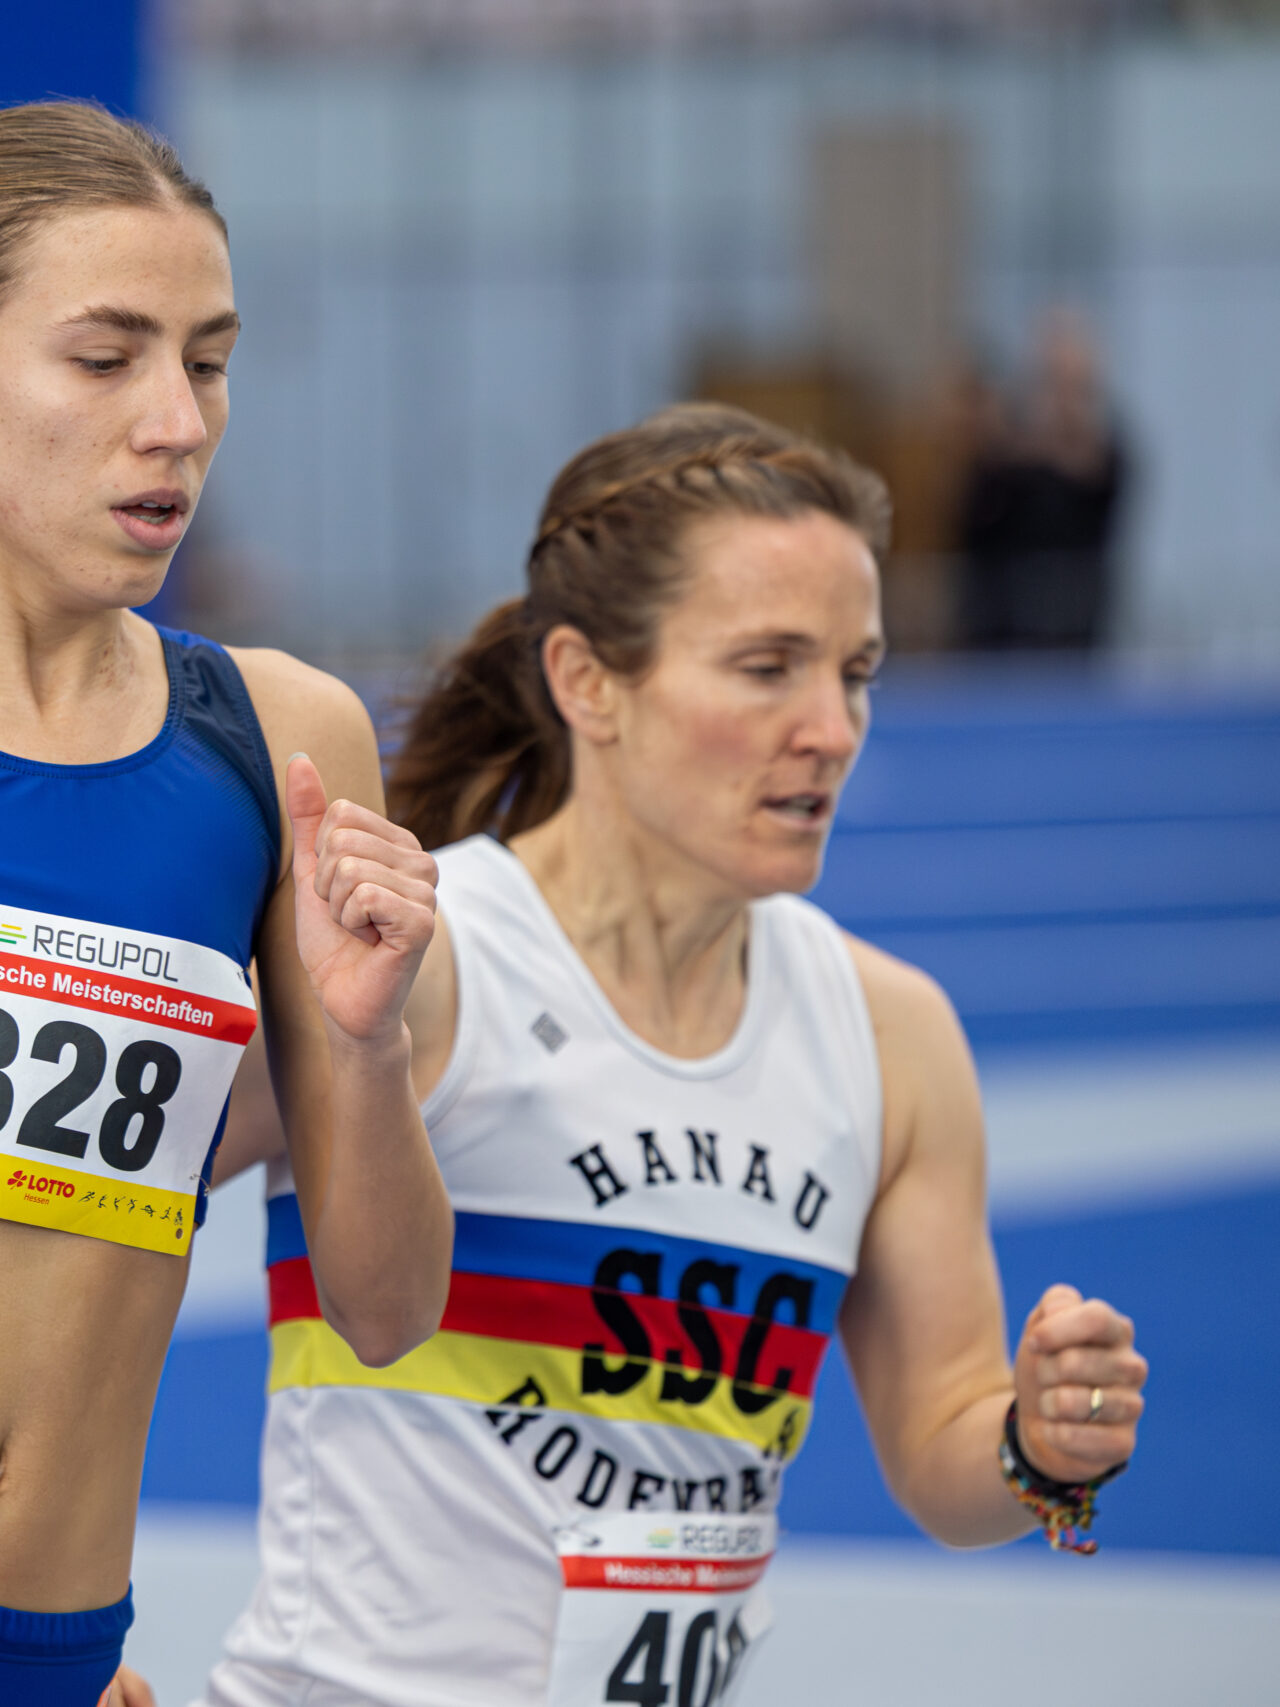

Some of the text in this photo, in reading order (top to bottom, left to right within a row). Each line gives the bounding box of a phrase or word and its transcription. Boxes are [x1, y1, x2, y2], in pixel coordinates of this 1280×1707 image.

[32, 924, 178, 982] REGUPOL
[51, 973, 214, 1028] Meisterschaften
[23, 1193, 51, 1206] Hessen
[27, 1174, 76, 1198] LOTTO
[569, 1128, 830, 1231] HANAU
[580, 1246, 817, 1415] SSC
